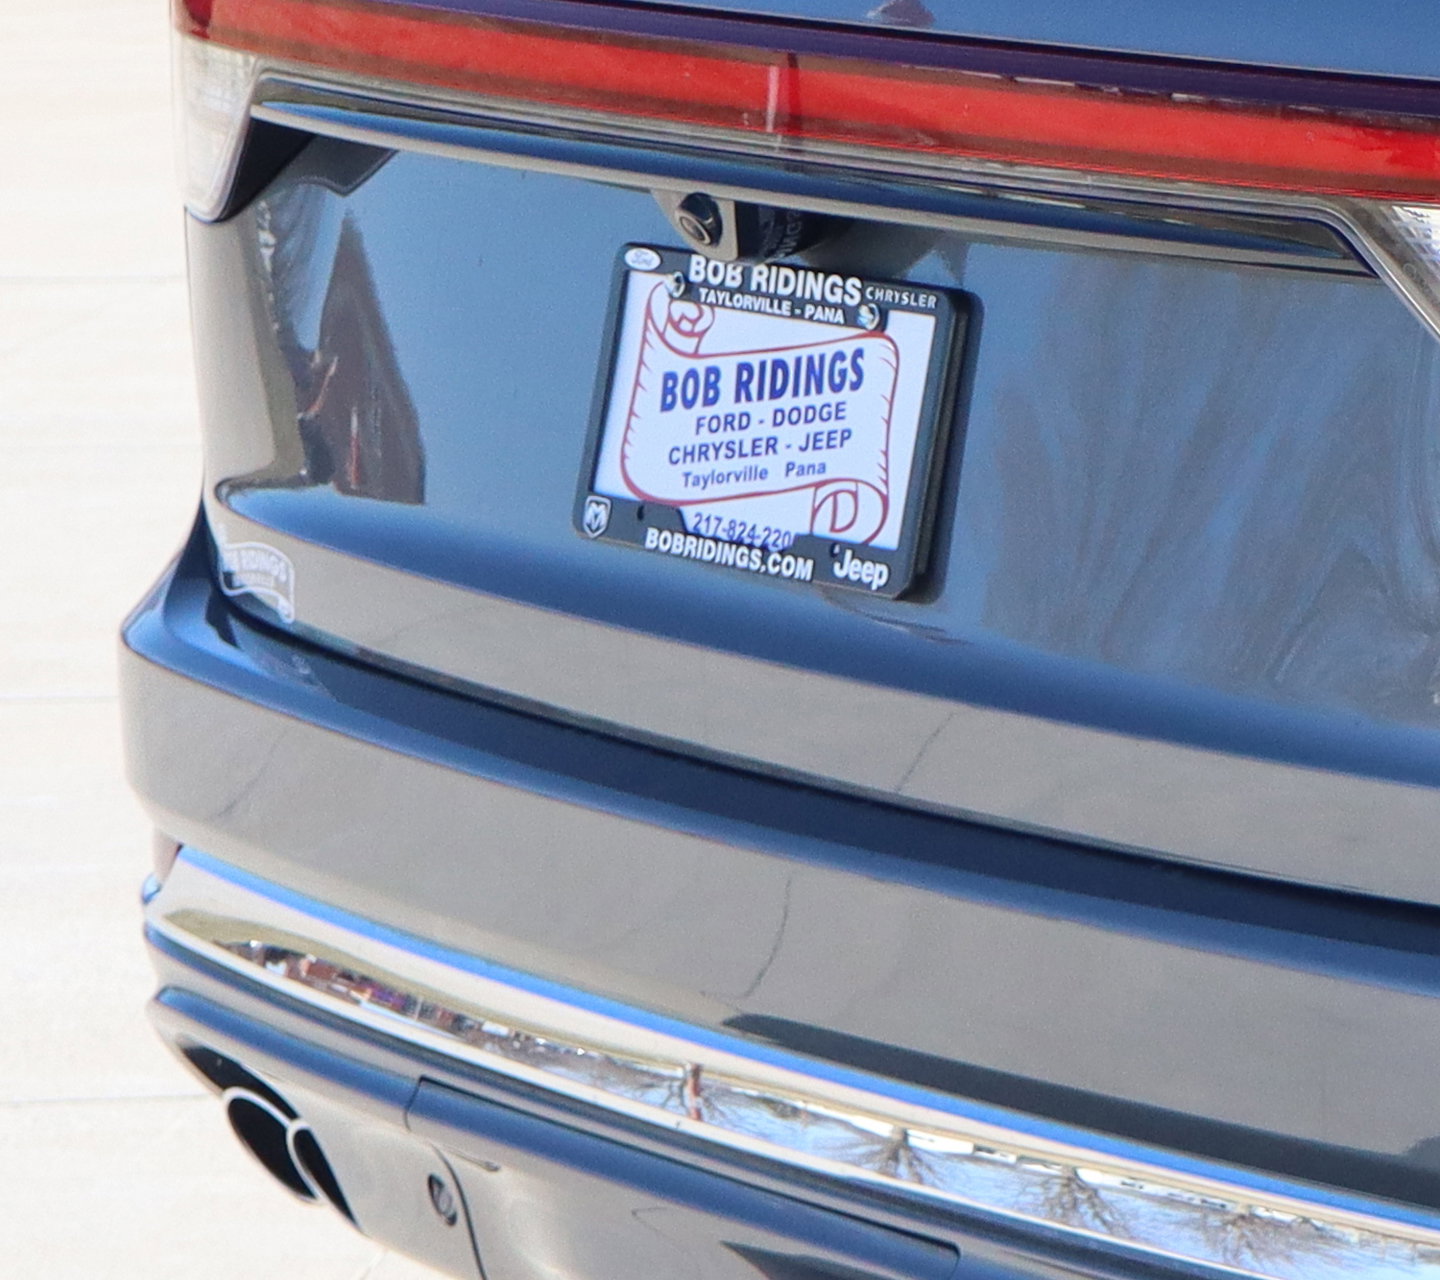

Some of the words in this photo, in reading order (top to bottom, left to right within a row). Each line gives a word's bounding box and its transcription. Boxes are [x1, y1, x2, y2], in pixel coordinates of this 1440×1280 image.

[688, 253, 743, 289] BOB
[750, 264, 863, 307] RIDINGS
[865, 286, 937, 309] CHRYSLER
[700, 287, 792, 316] TAYLORVILLE
[804, 303, 845, 325] PANA
[660, 365, 722, 413] BOB
[734, 347, 865, 404] RIDINGS
[695, 411, 751, 435] FORD
[772, 401, 847, 428] DODGE
[668, 435, 779, 466] CHRYSLER
[798, 428, 853, 453] JEEP
[682, 464, 769, 491] Taylorville
[785, 461, 827, 478] Pana
[834, 549, 889, 591] Jeep
